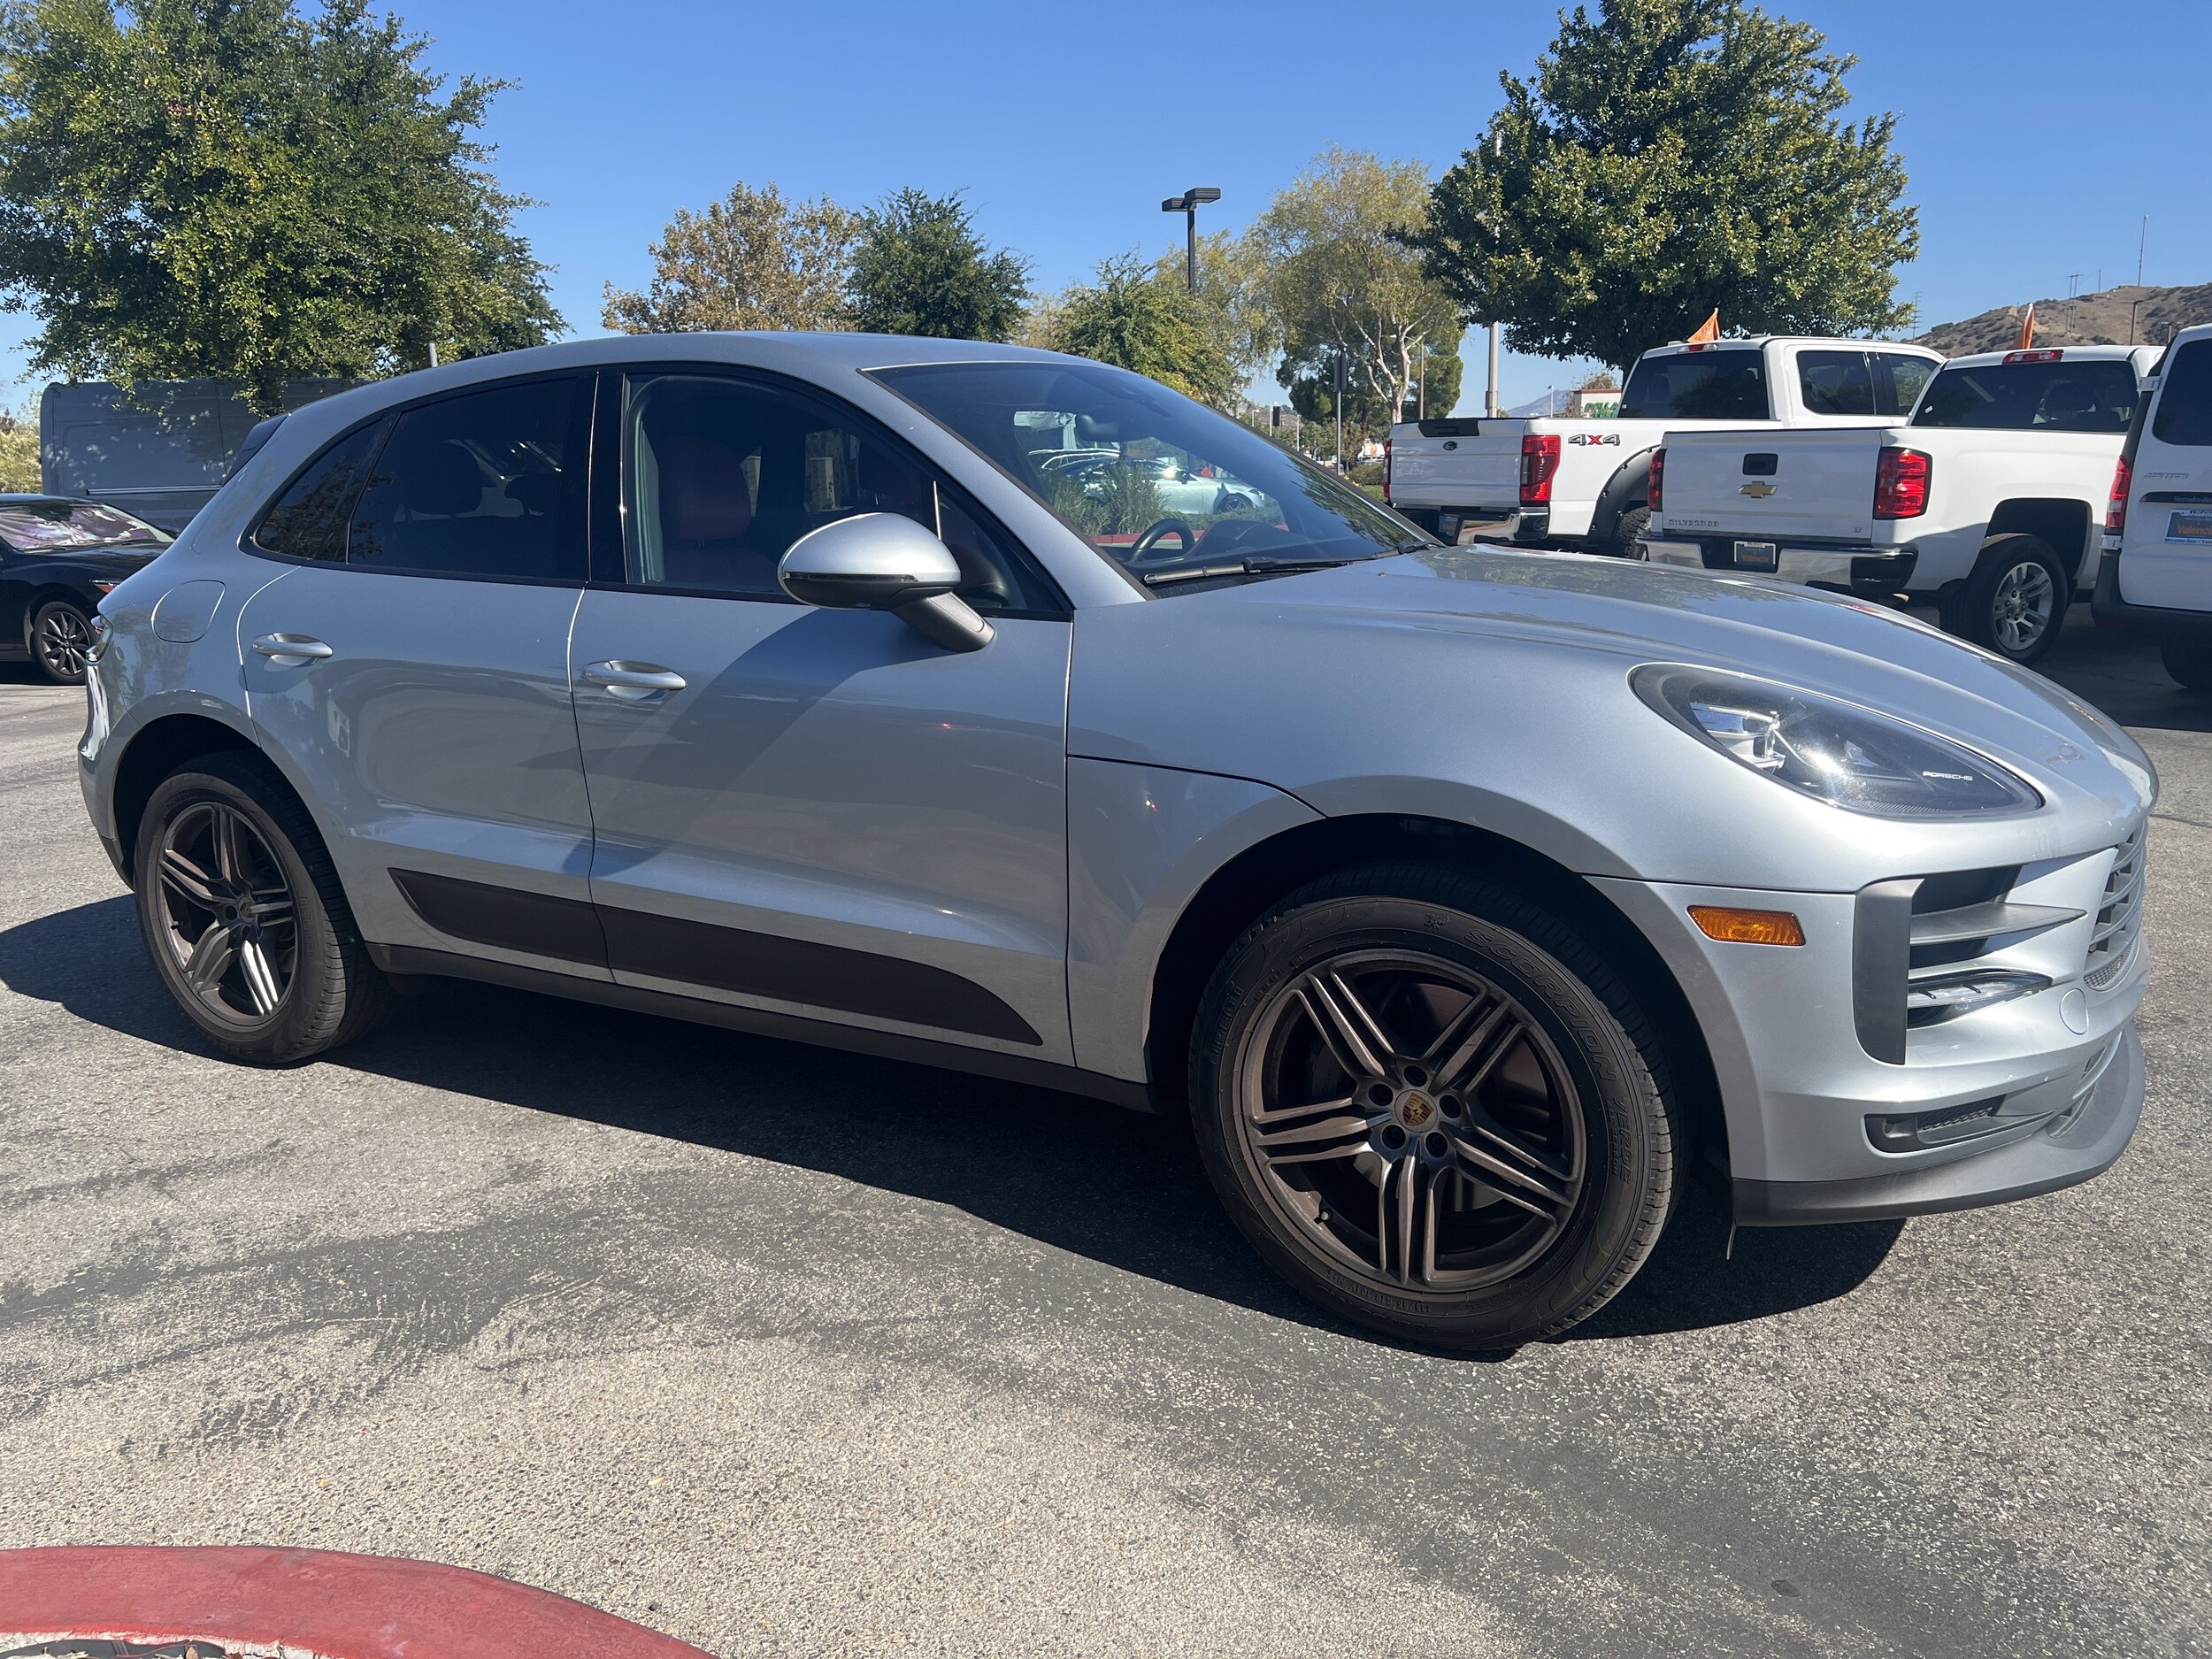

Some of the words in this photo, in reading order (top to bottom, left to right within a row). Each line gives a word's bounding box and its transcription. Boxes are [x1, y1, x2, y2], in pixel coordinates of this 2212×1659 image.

[1669, 518, 1719, 527] SILVERADO
[2177, 524, 2212, 535] Valenci
[1923, 771, 1973, 781] PORSCHE
[1464, 929, 1617, 1081] SCORPION
[1613, 1094, 1632, 1184] VERDE
